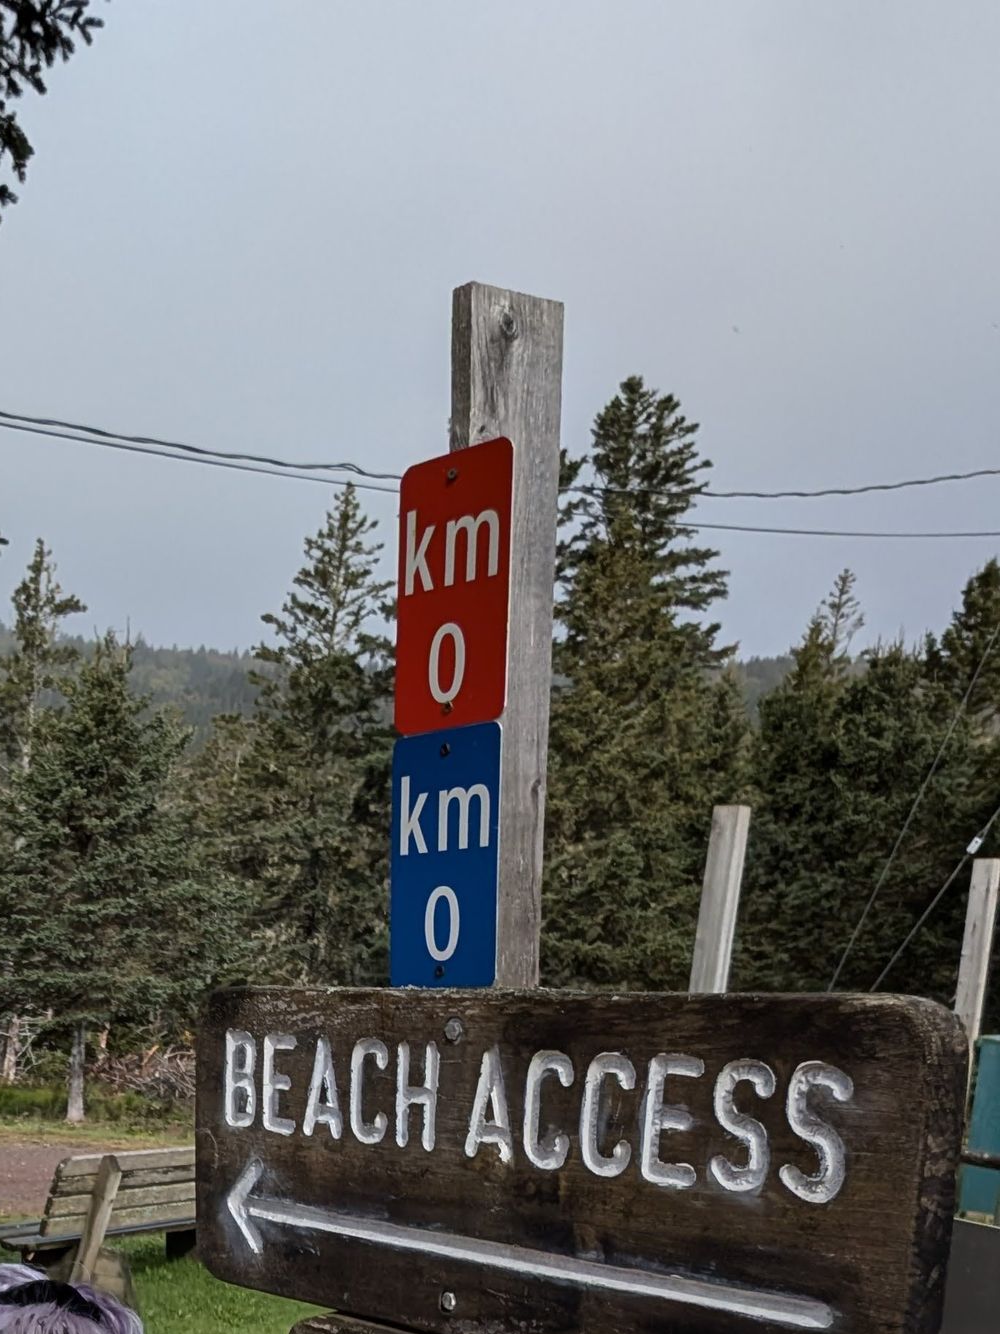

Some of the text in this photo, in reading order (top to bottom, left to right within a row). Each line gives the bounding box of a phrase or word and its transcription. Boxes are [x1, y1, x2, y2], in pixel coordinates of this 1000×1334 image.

[403, 507, 500, 596] km
[430, 622, 466, 704] 0
[399, 776, 491, 856] km
[424, 885, 461, 962] 0
[224, 1030, 855, 1204] BEACH ACCESS
